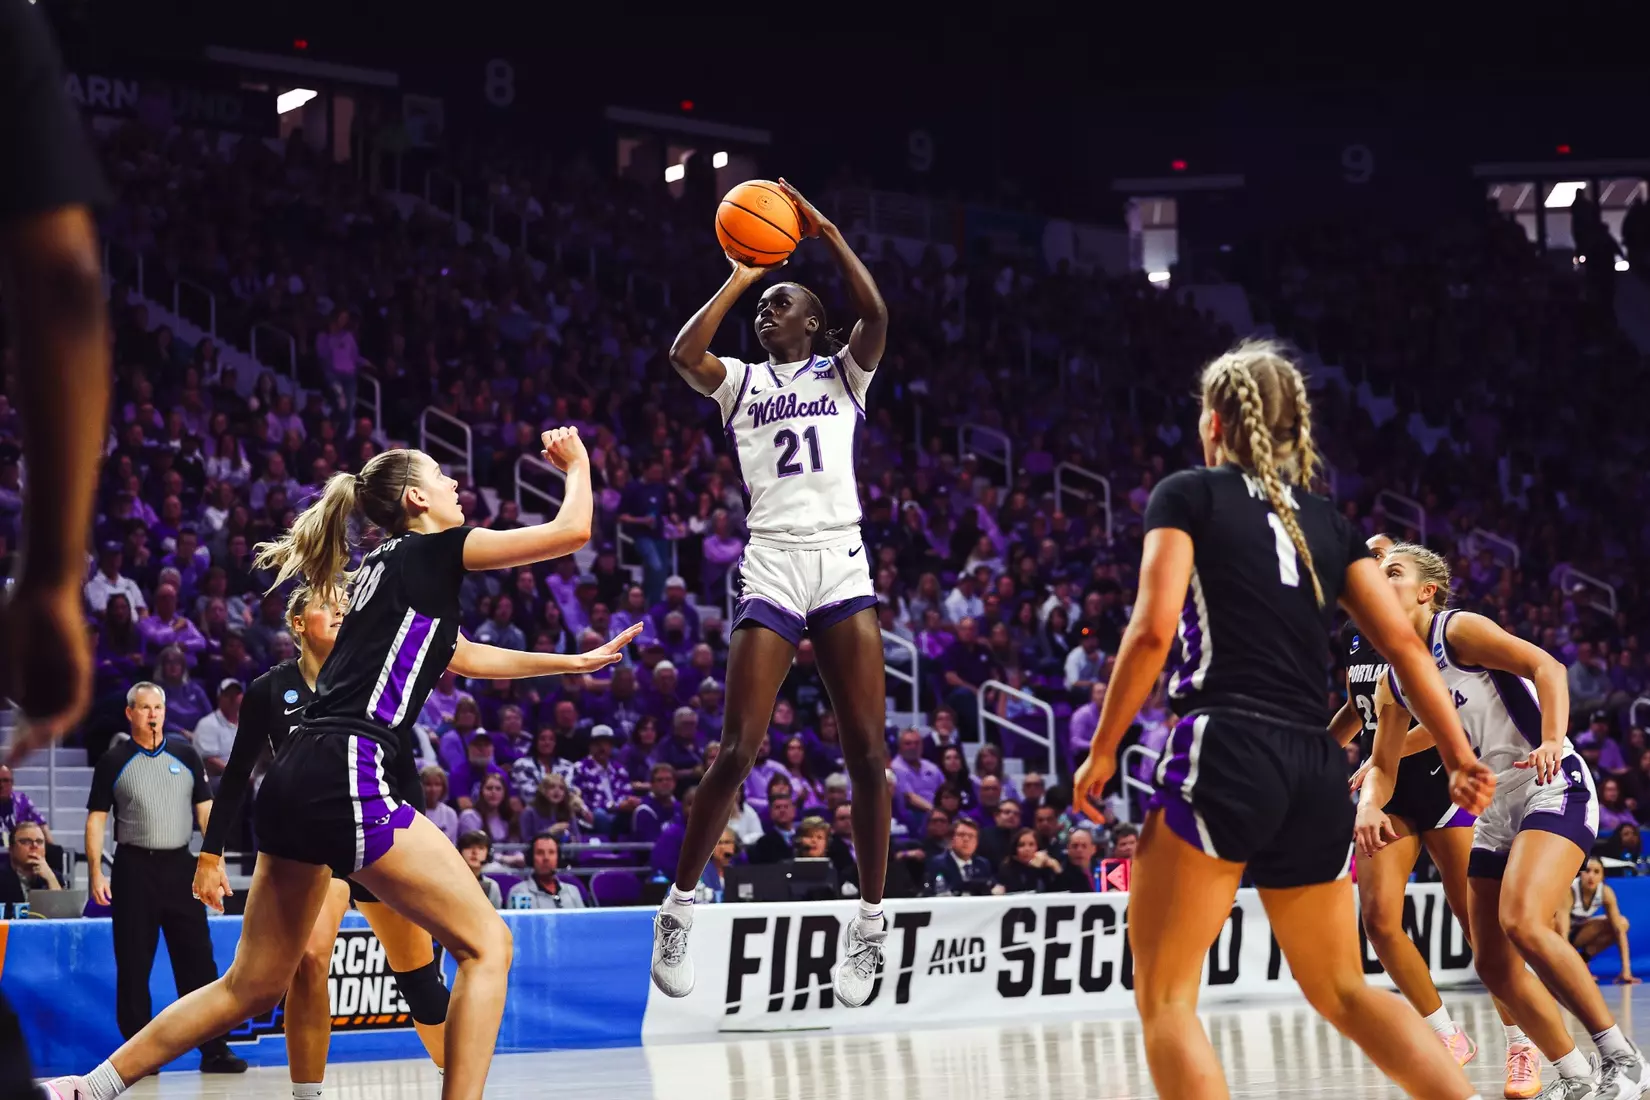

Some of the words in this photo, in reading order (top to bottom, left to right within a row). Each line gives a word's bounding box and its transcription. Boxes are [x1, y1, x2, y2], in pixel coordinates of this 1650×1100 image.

[484, 58, 514, 107] 8
[907, 129, 935, 172] 9
[1342, 144, 1374, 184] 9
[747, 392, 839, 429] Wildcats
[773, 425, 824, 478] 21
[1267, 512, 1300, 588] 1
[927, 936, 987, 976] AND
[997, 903, 1244, 998] SECD
